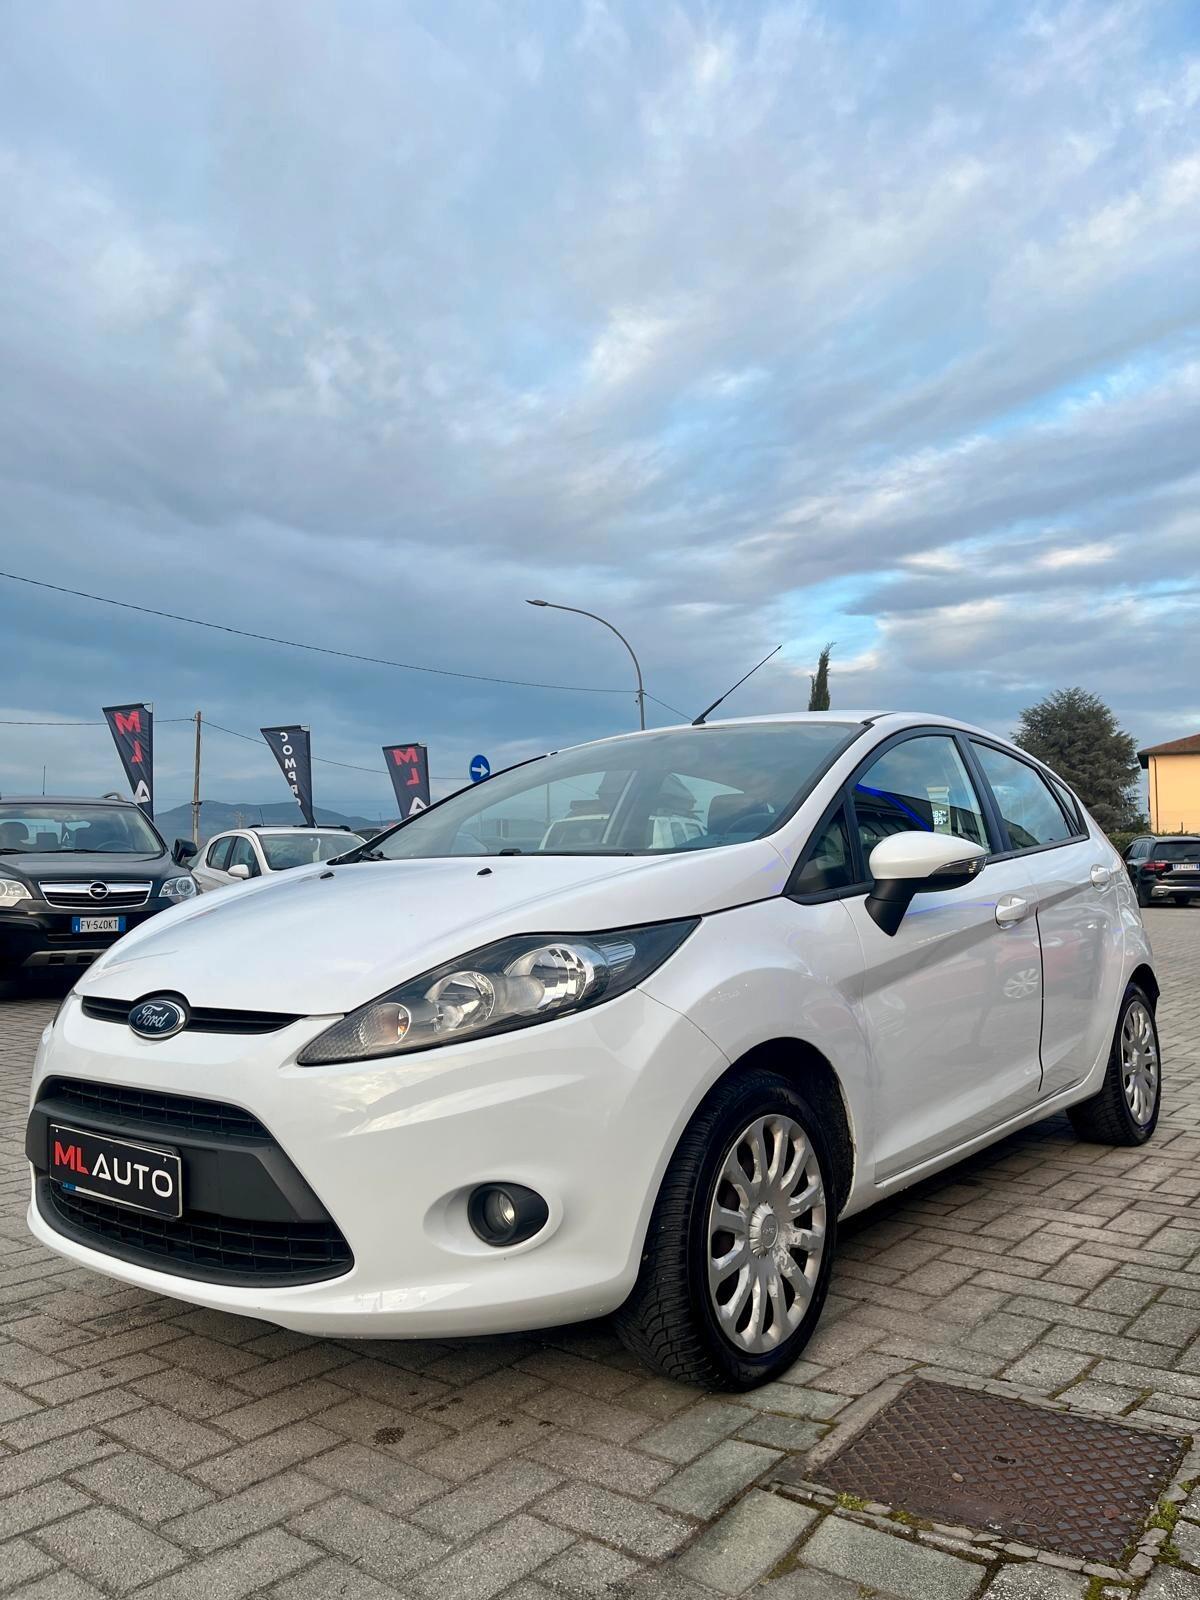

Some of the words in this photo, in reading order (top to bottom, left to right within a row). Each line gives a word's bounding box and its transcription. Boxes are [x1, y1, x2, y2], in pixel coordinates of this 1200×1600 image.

[136, 1004, 169, 1028] Ford
[54, 1141, 89, 1175] ML
[91, 1152, 173, 1198] AUTO
